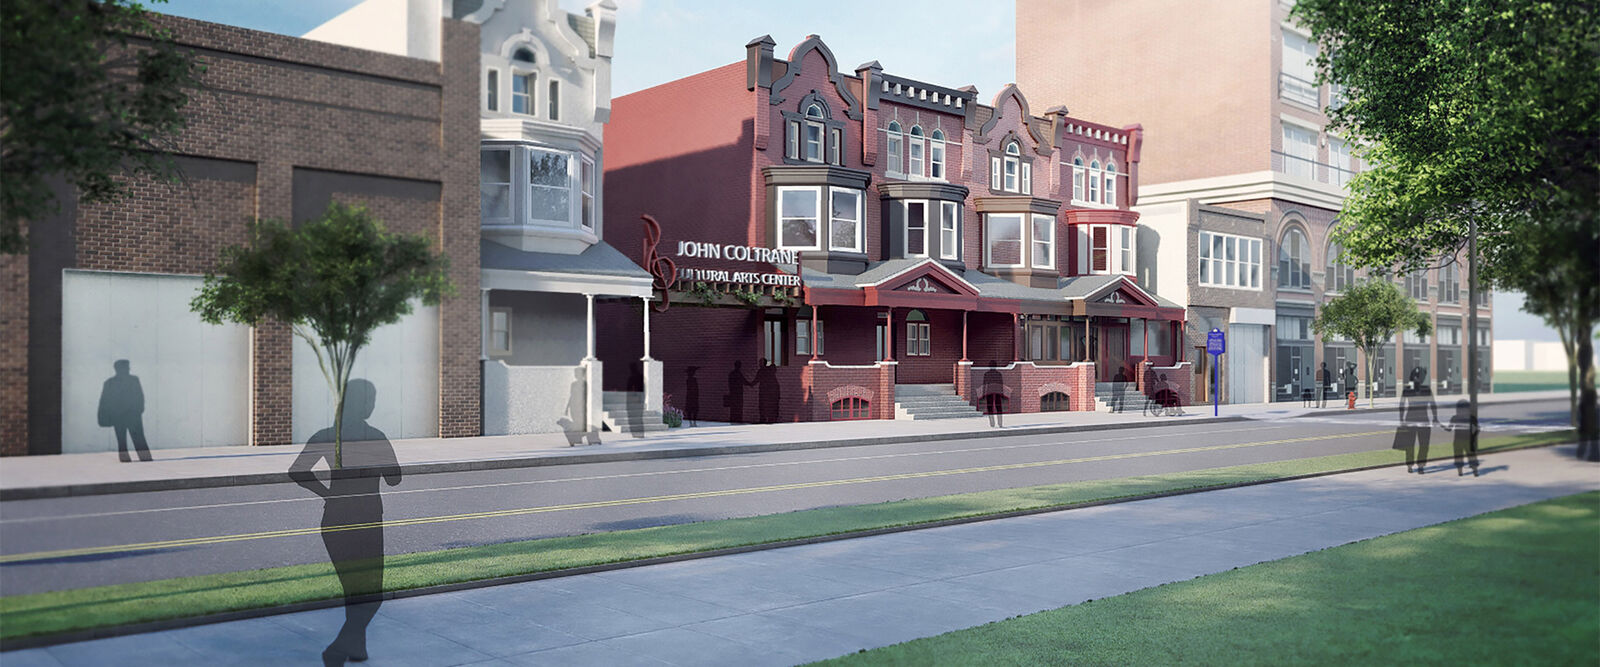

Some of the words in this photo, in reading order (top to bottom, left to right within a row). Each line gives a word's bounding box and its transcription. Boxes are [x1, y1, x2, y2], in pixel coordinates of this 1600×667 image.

[677, 240, 720, 259] JOHN
[723, 244, 799, 265] COLTRANE
[675, 267, 733, 282] ULTURAL
[732, 271, 760, 284] ARTS
[761, 273, 800, 287] CENTER
